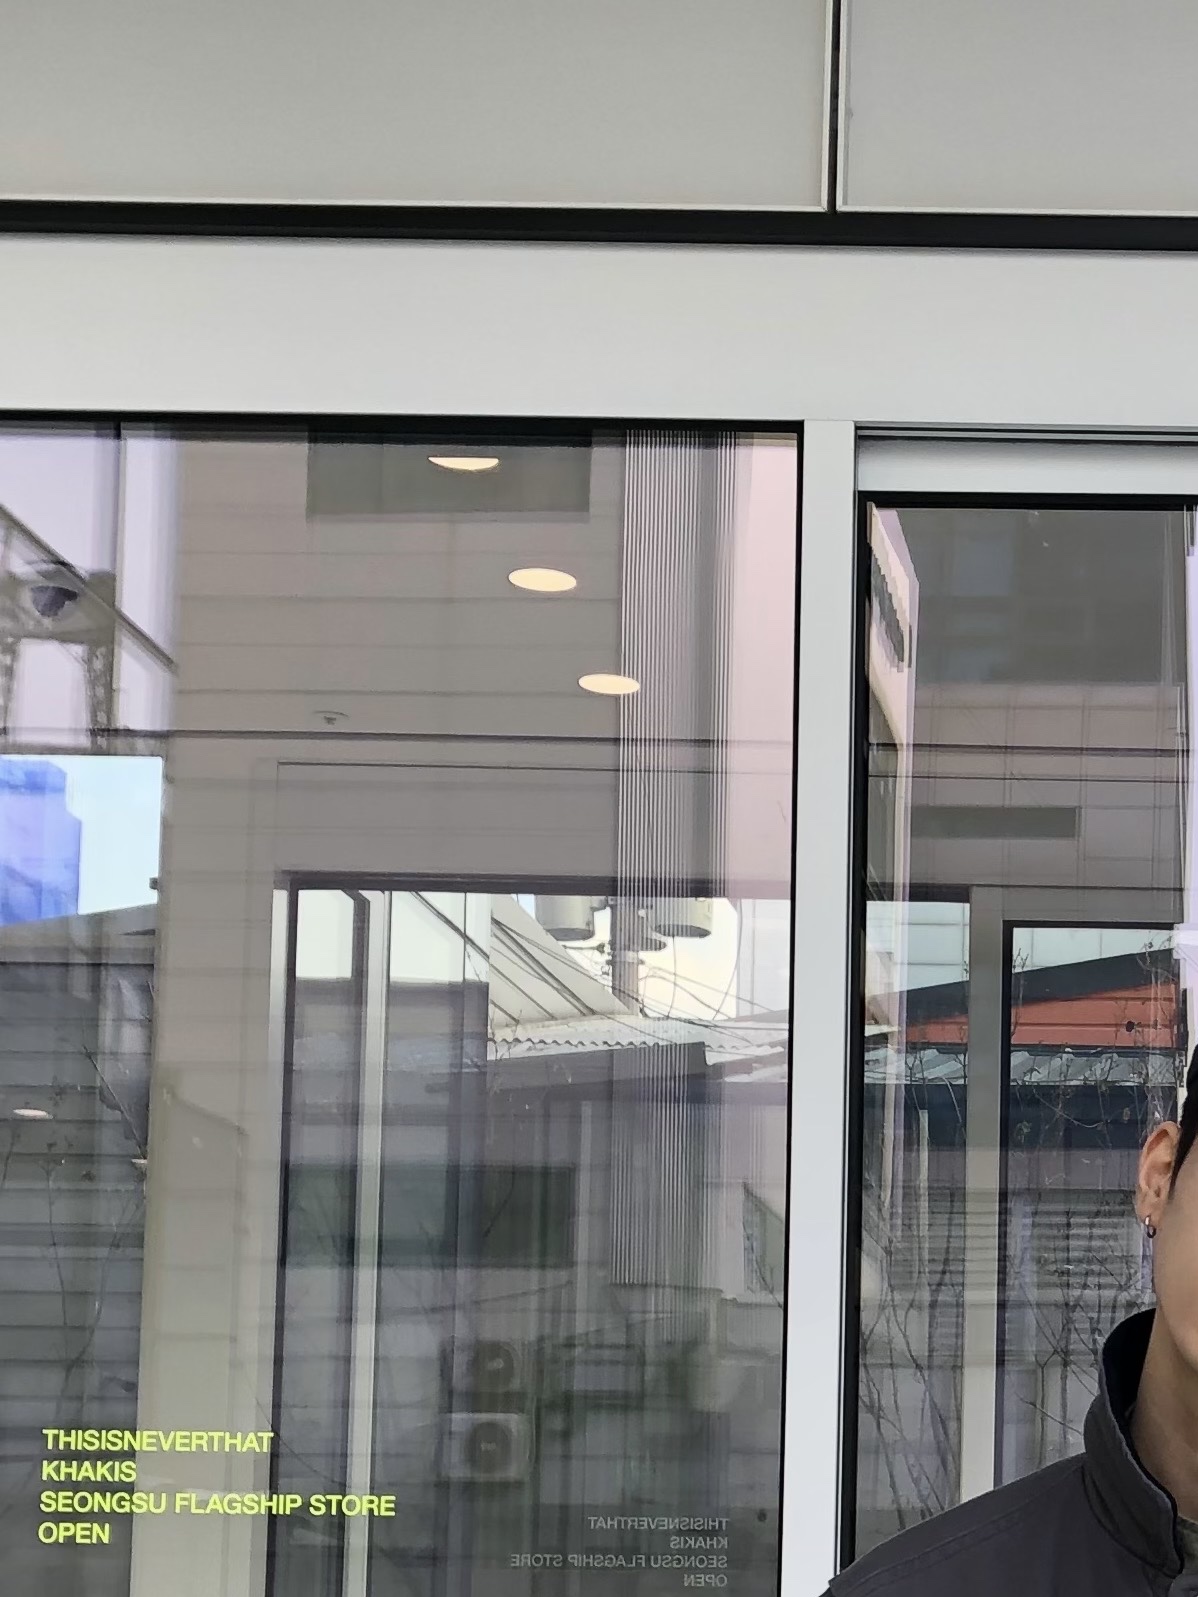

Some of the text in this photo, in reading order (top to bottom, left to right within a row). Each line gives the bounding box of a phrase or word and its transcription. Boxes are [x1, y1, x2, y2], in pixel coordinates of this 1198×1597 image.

[41, 1428, 274, 1453] THISISNEVERTHAT
[40, 1460, 138, 1483] KHAKIS
[39, 1491, 396, 1517] SEONGSU FLAGSHIP STORE
[37, 1521, 110, 1545] OPEN
